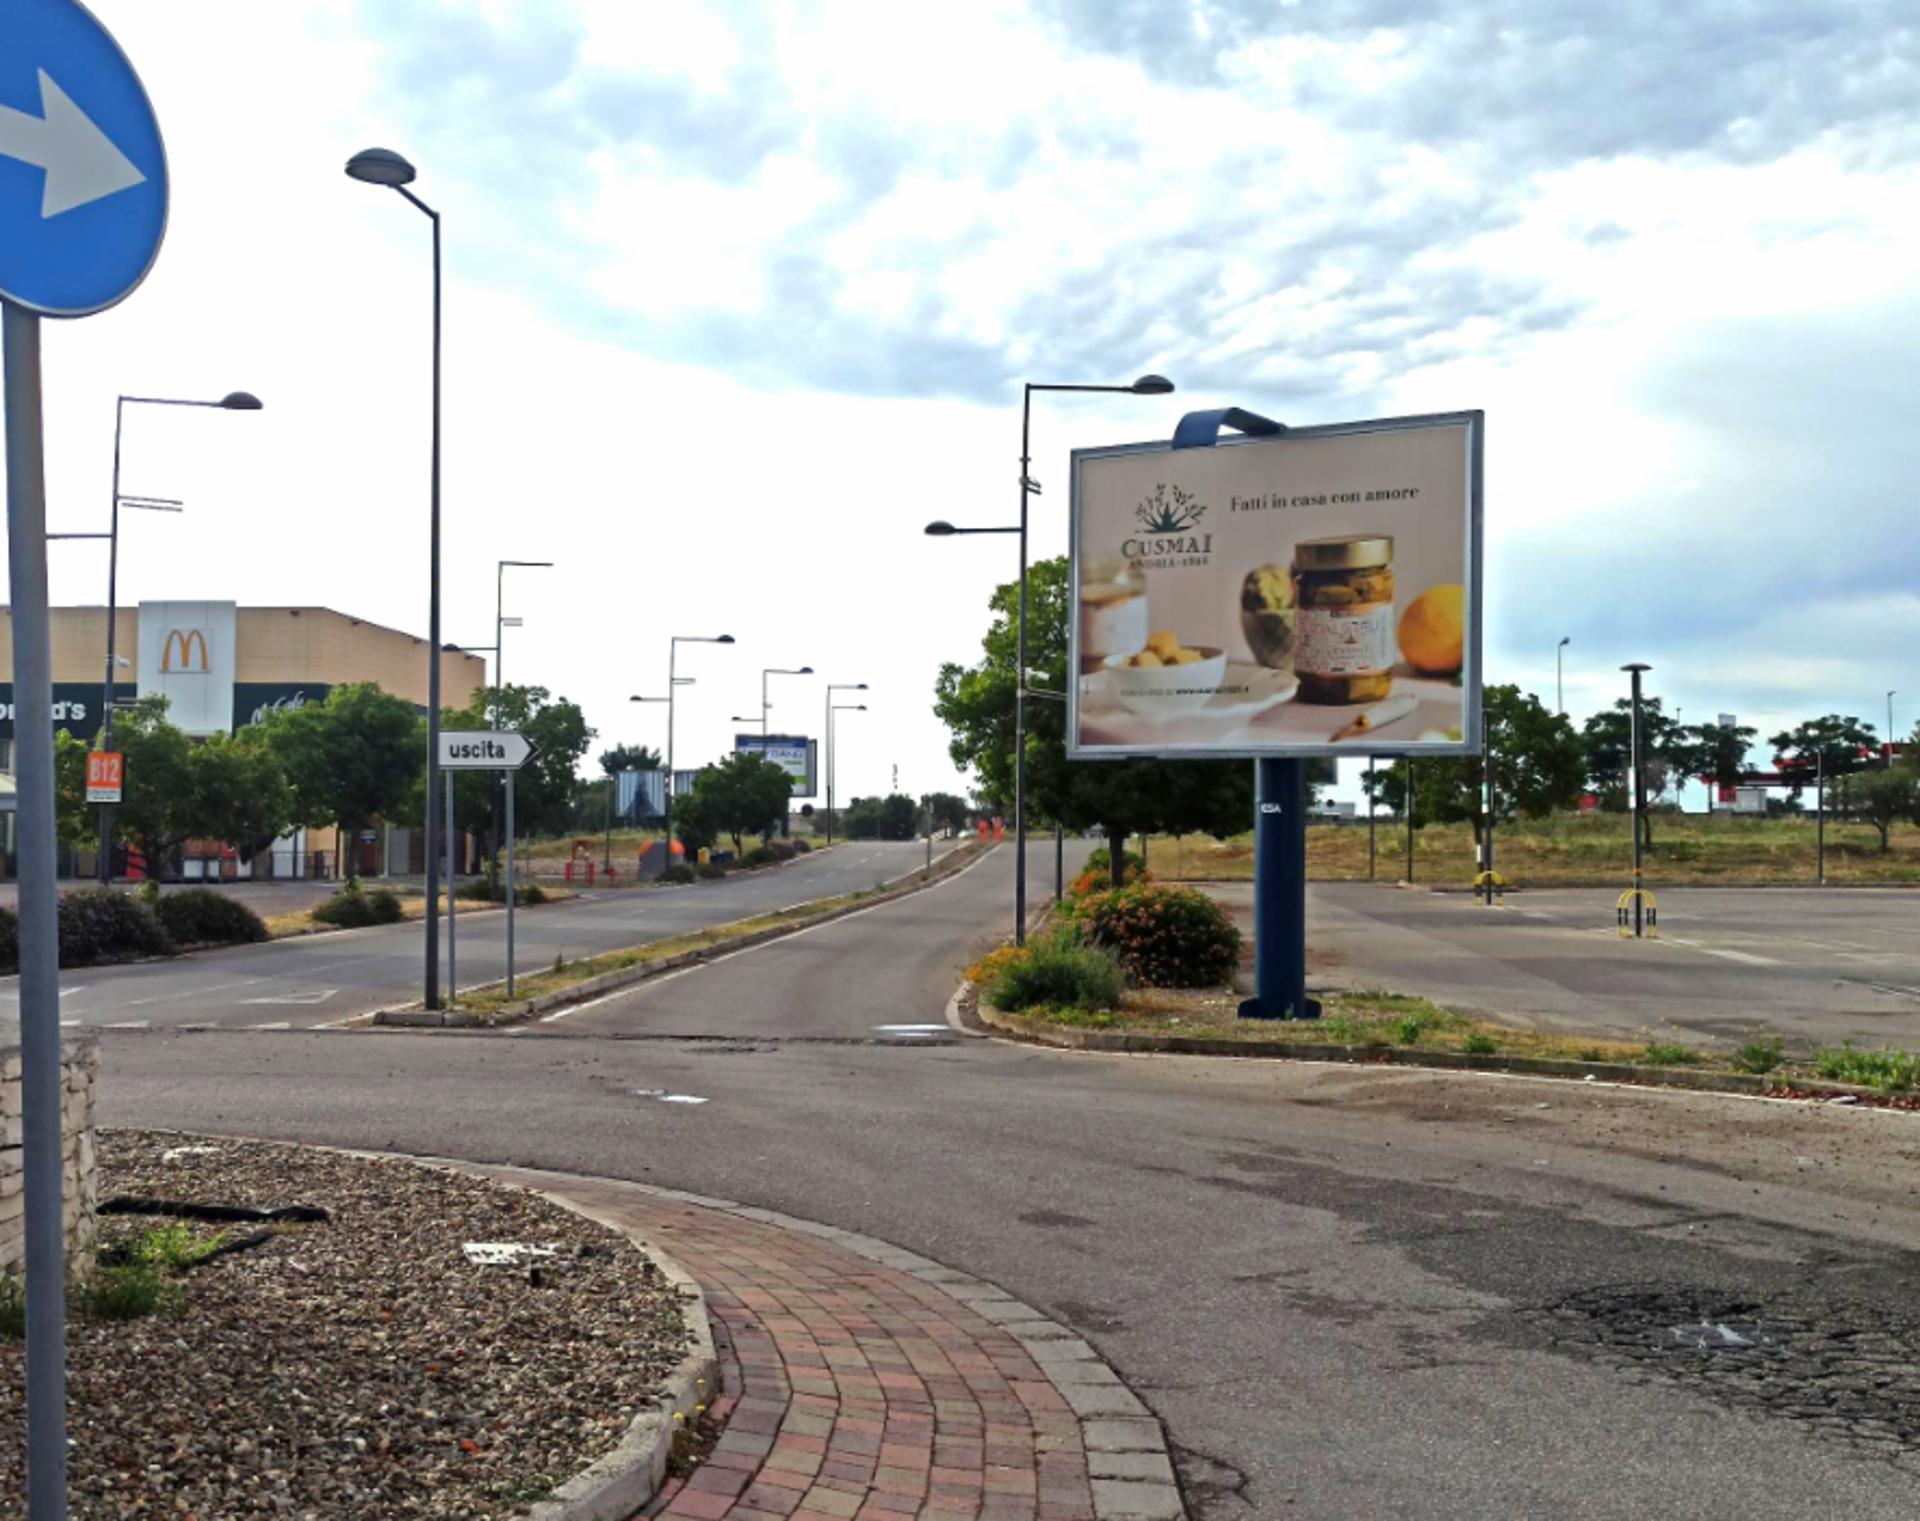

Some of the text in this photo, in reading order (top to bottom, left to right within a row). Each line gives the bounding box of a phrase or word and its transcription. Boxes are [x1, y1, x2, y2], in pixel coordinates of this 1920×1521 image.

[1230, 486, 1420, 513] Fatti in casa con amore
[1121, 533, 1212, 559] CUSMAI
[449, 740, 506, 759] uscita
[90, 757, 120, 783] B12
